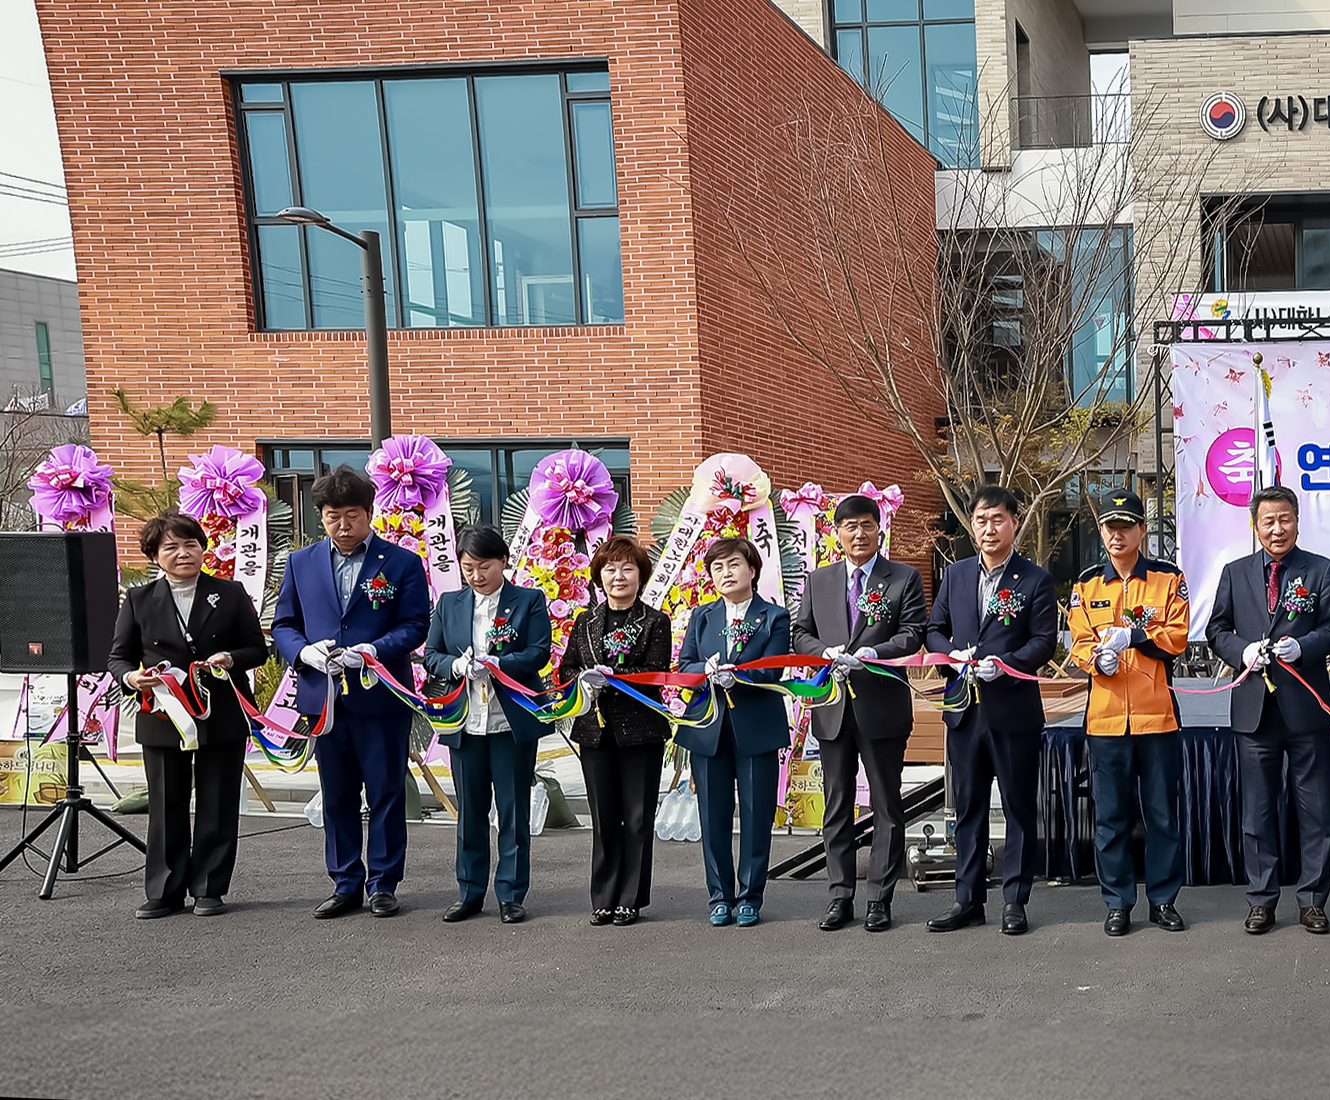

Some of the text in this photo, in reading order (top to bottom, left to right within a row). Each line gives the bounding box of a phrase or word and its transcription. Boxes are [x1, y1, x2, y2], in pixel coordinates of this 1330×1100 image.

[239, 524, 262, 576] 개관을
[427, 514, 454, 572] 개관을
[754, 517, 774, 558] 축
